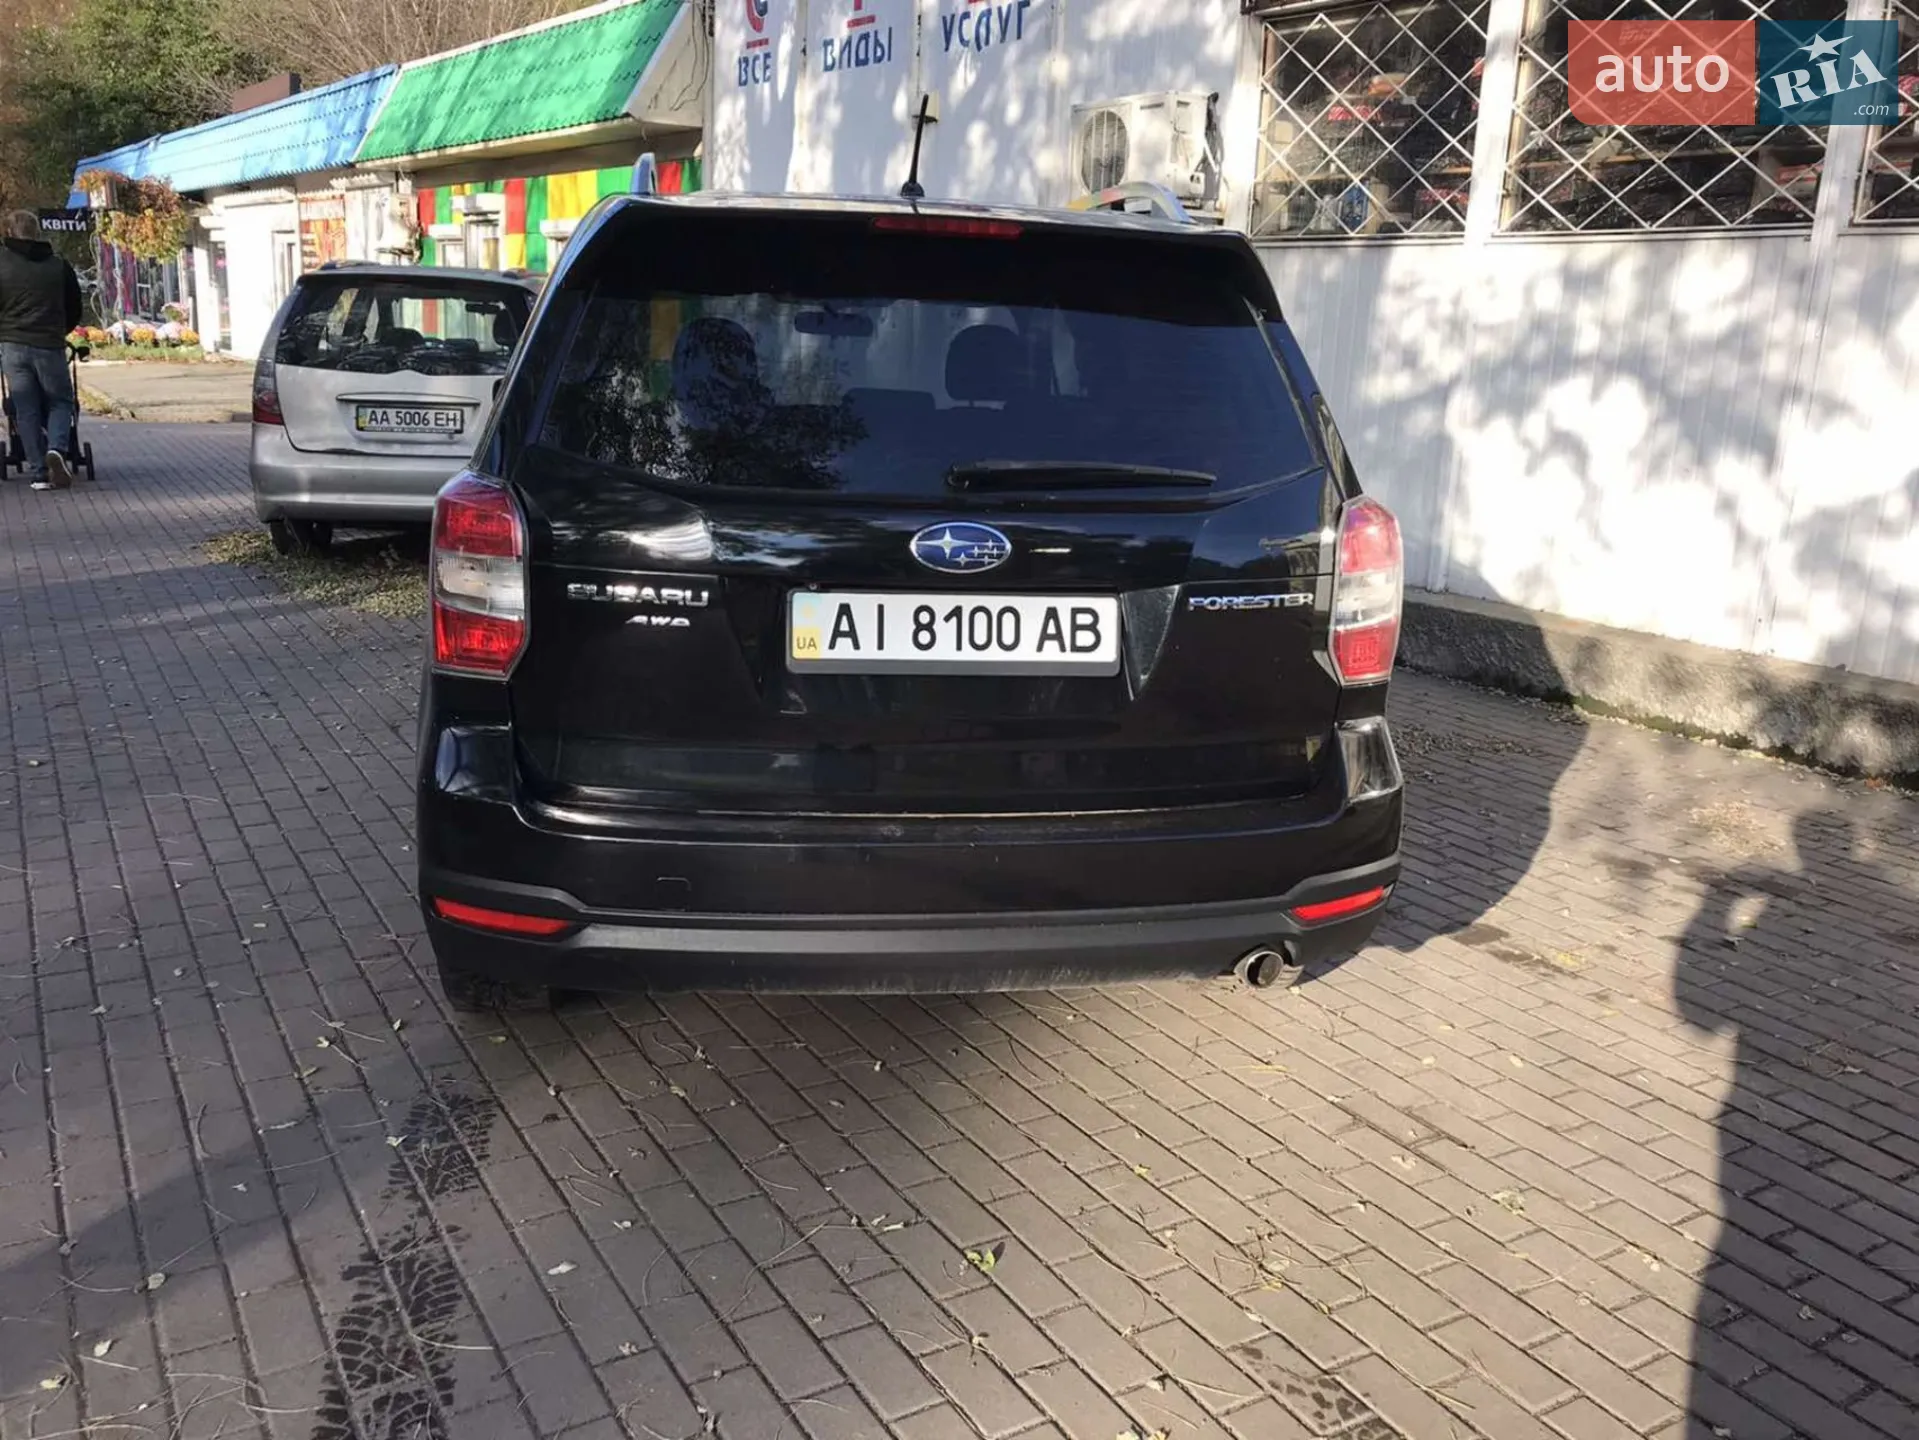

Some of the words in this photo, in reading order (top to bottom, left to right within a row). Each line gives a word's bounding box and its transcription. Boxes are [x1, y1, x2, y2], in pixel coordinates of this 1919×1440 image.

[738, 52, 772, 87] ВСЕ
[822, 26, 893, 73] ВИДЫ
[941, 1, 1030, 52] УСЛУГ
[41, 218, 87, 231] КВІТИ
[368, 409, 390, 425] AA
[395, 410, 430, 426] 5006
[434, 412, 457, 427] EH
[567, 583, 709, 606] SUBARU
[1188, 592, 1314, 611] FORESTER
[625, 614, 690, 627] AWD
[828, 603, 885, 651] AI
[911, 604, 1021, 652] 8100
[1036, 606, 1102, 653] AB
[796, 636, 817, 650] UA
